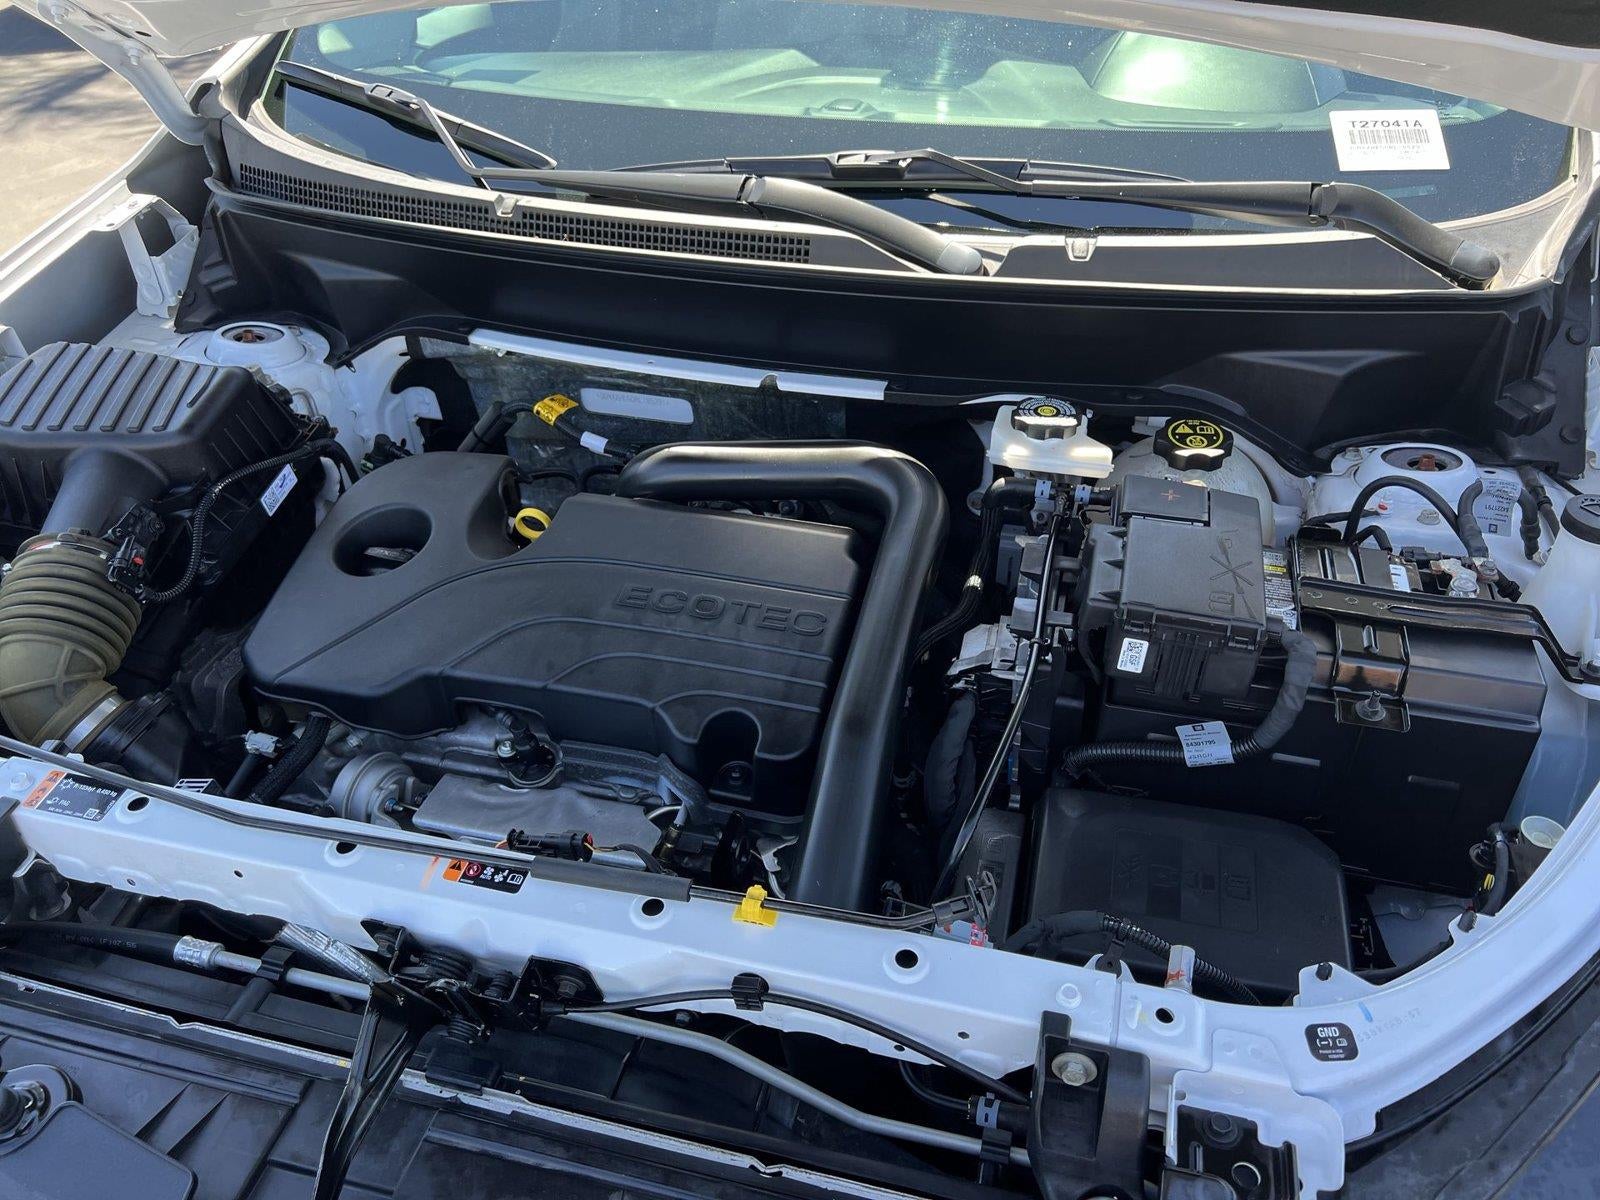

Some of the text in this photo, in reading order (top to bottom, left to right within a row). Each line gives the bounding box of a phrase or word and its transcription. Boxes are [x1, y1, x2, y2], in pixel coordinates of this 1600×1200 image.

[1348, 120, 1423, 128] T27041A
[615, 584, 828, 637] ECOTEC
[1317, 1026, 1340, 1038] GND
